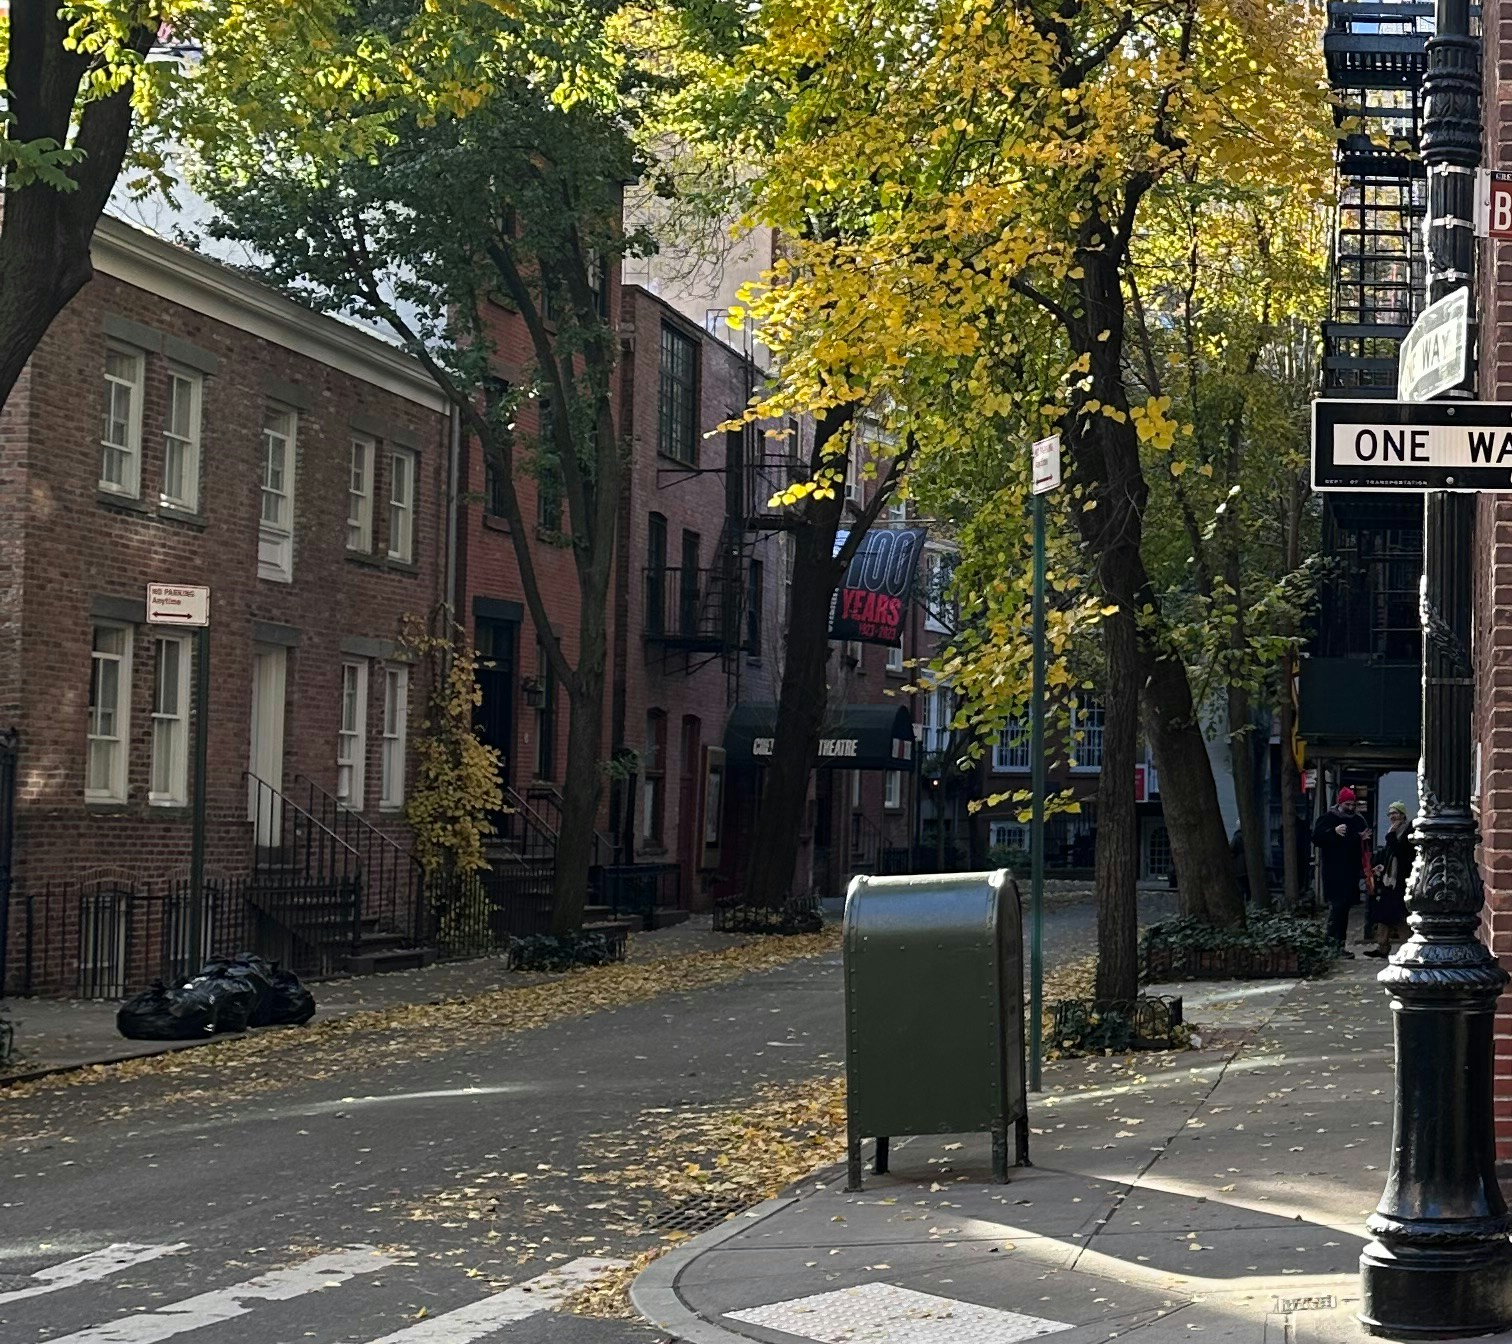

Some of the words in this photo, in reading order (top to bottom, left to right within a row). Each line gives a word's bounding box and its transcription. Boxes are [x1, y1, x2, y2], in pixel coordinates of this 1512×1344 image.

[1422, 328, 1452, 371] WAY
[1355, 429, 1430, 462] ONE
[846, 531, 917, 596] 100
[152, 588, 163, 596] NO
[164, 588, 195, 598] PARKING
[152, 596, 182, 606] Anytime
[842, 588, 902, 627] YEARS
[818, 739, 859, 757] THEATRE
